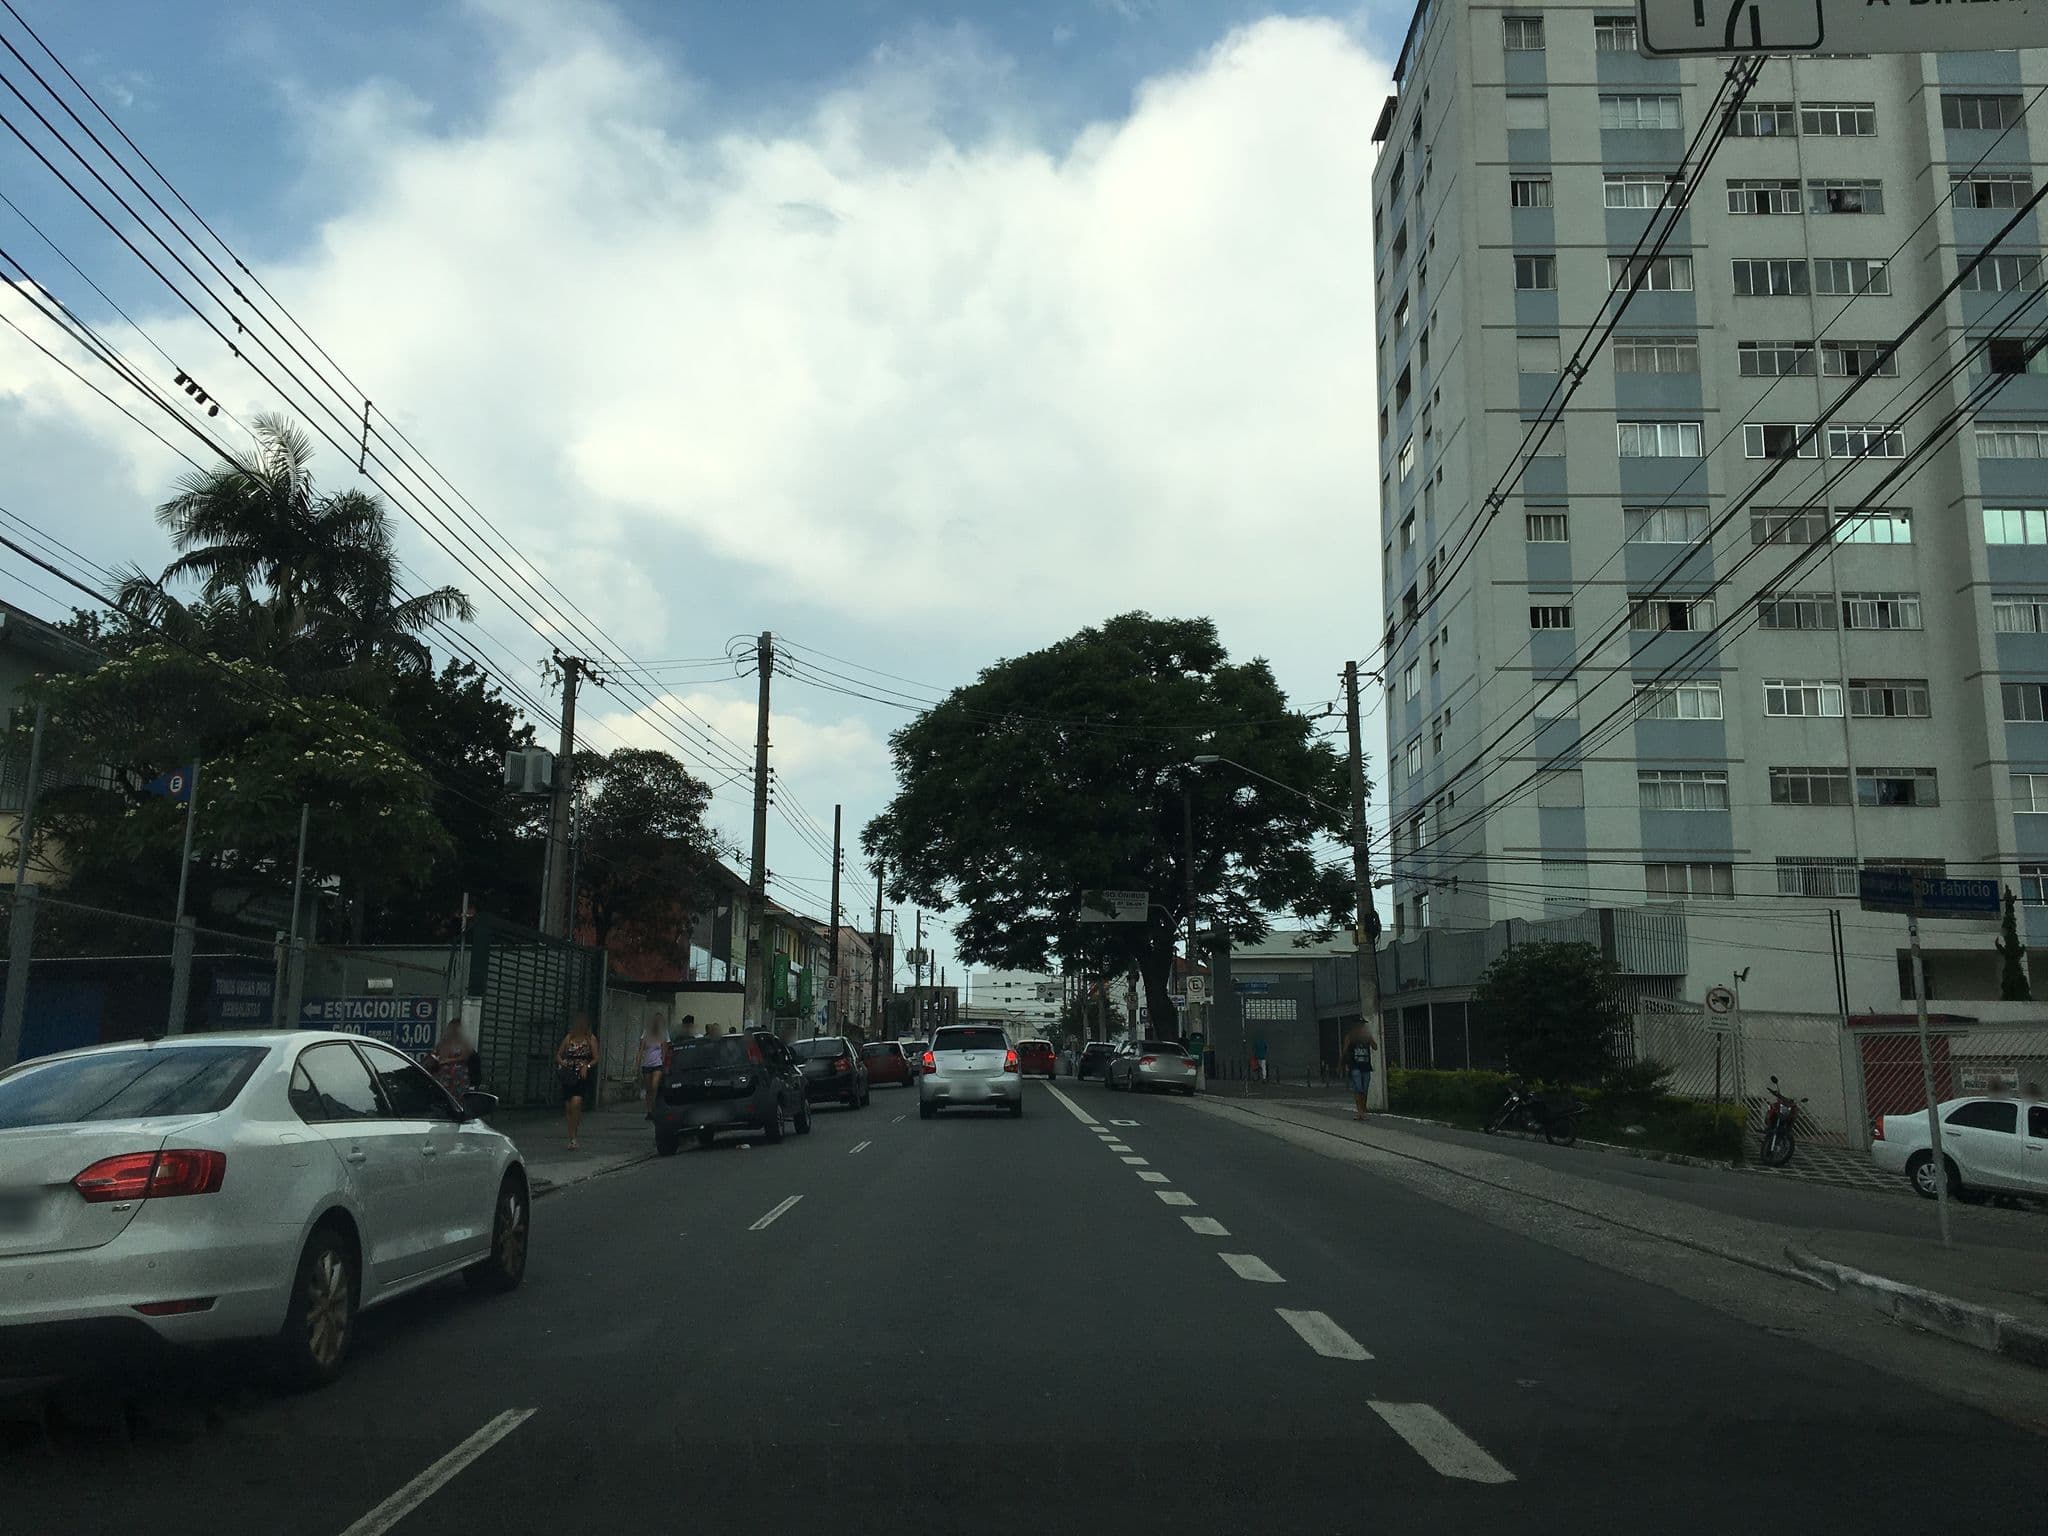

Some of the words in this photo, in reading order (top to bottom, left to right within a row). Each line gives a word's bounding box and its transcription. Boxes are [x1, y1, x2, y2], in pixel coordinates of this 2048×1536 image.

[1921, 880, 1938, 897] Dr.
[1940, 880, 1991, 897] Fabrício
[323, 1001, 412, 1019] ESTACIONE
[401, 1023, 432, 1047] 3,00
